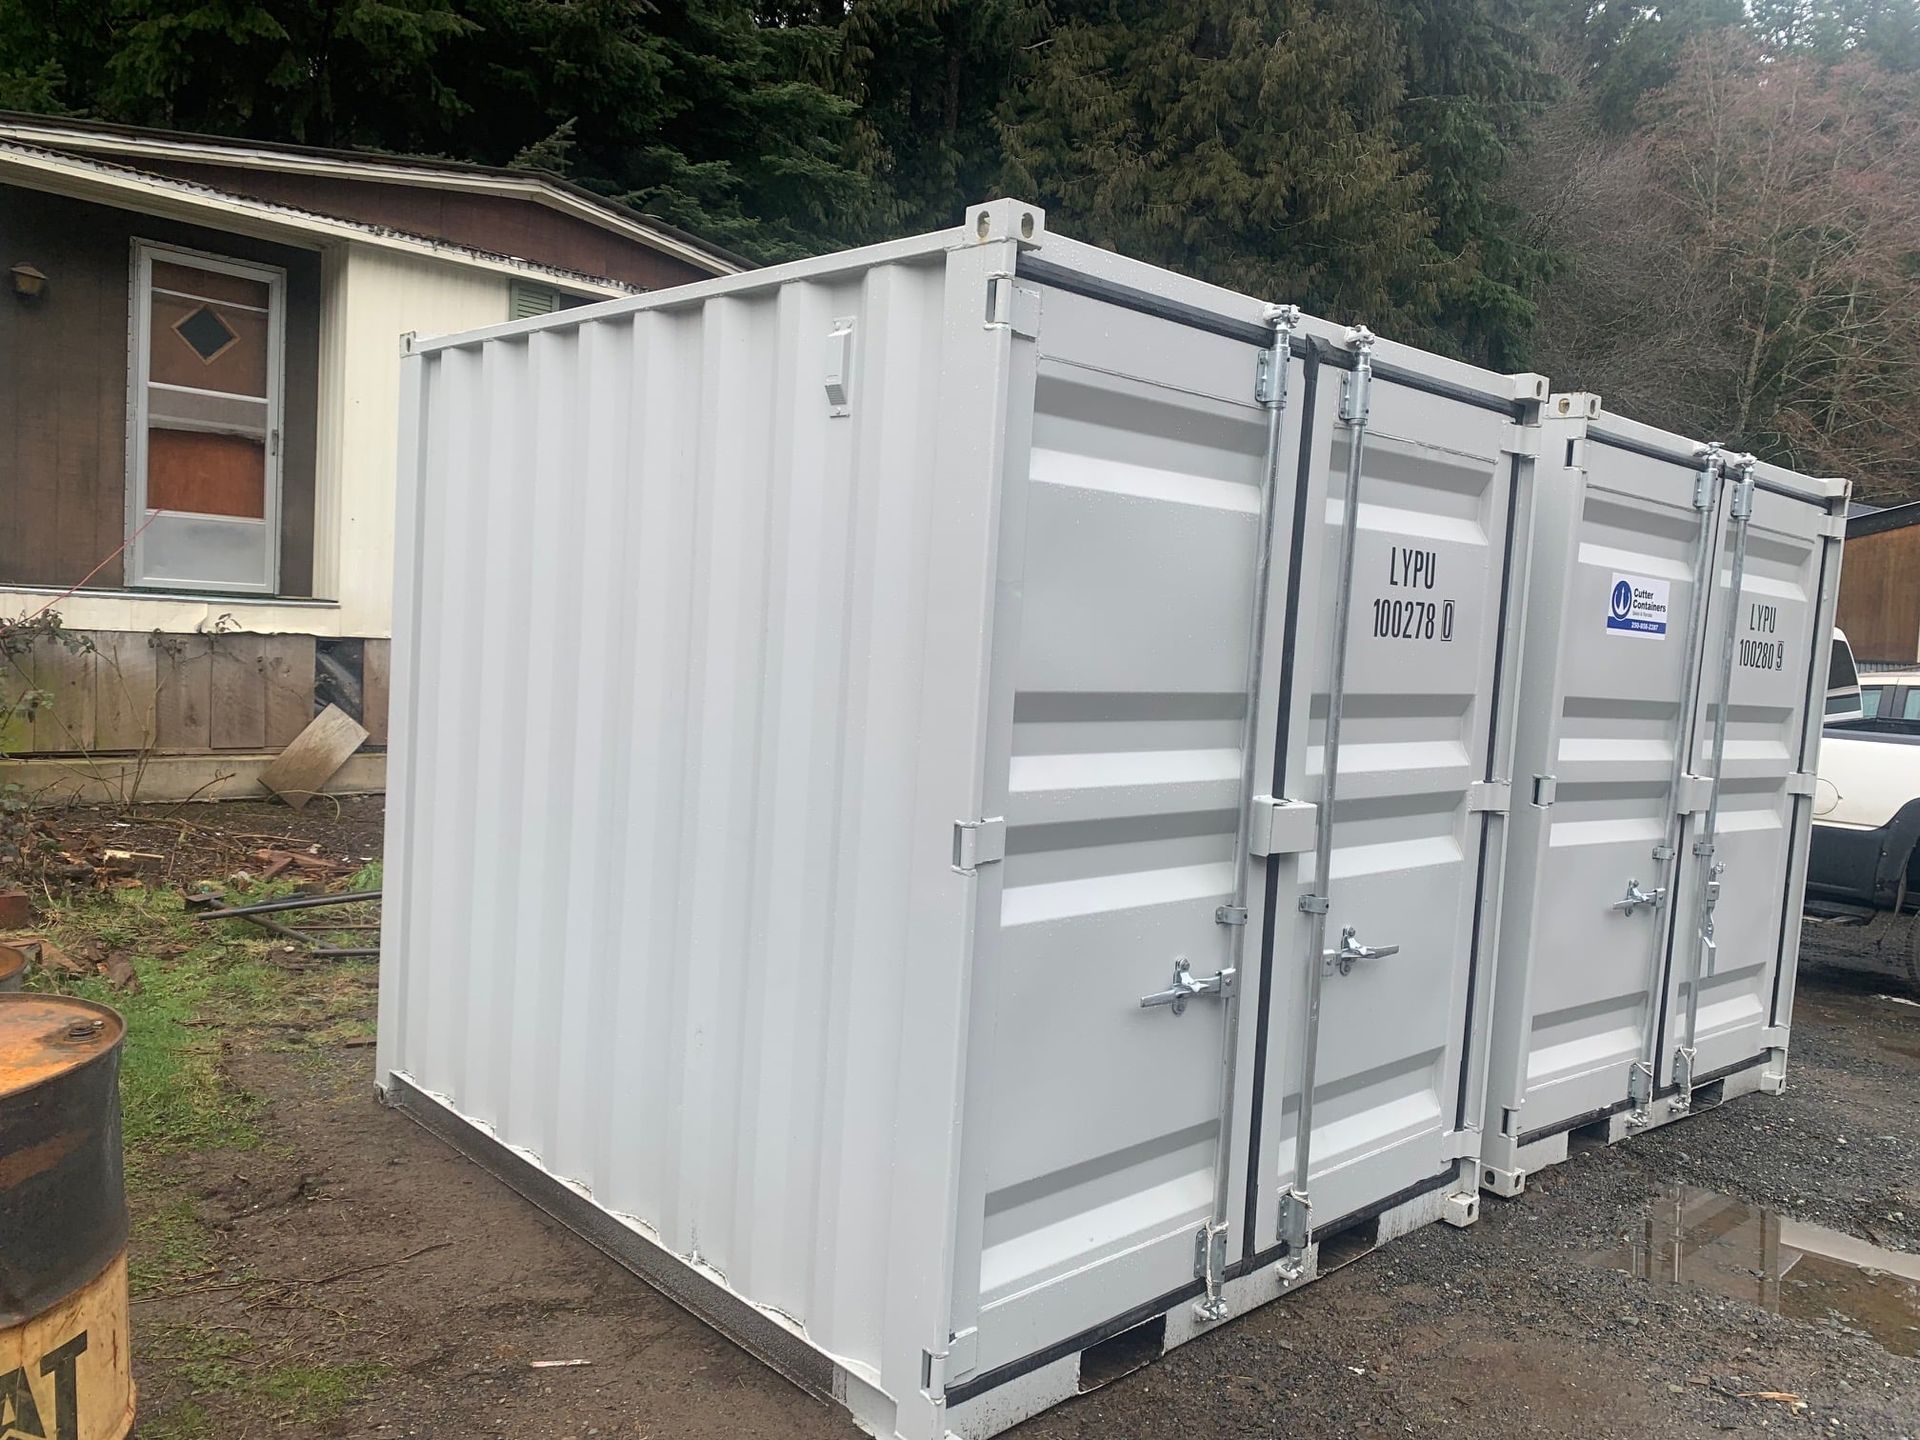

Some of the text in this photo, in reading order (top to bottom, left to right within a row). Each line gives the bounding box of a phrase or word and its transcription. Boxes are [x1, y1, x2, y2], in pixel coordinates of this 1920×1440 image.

[1390, 547, 1436, 589] LYPU
[1632, 599, 1667, 613] Containers
[1633, 588, 1654, 600] Cutter
[1373, 599, 1454, 640] 100278 0
[1750, 603, 1777, 633] LYPU
[1739, 639, 1784, 670] 100280 9
